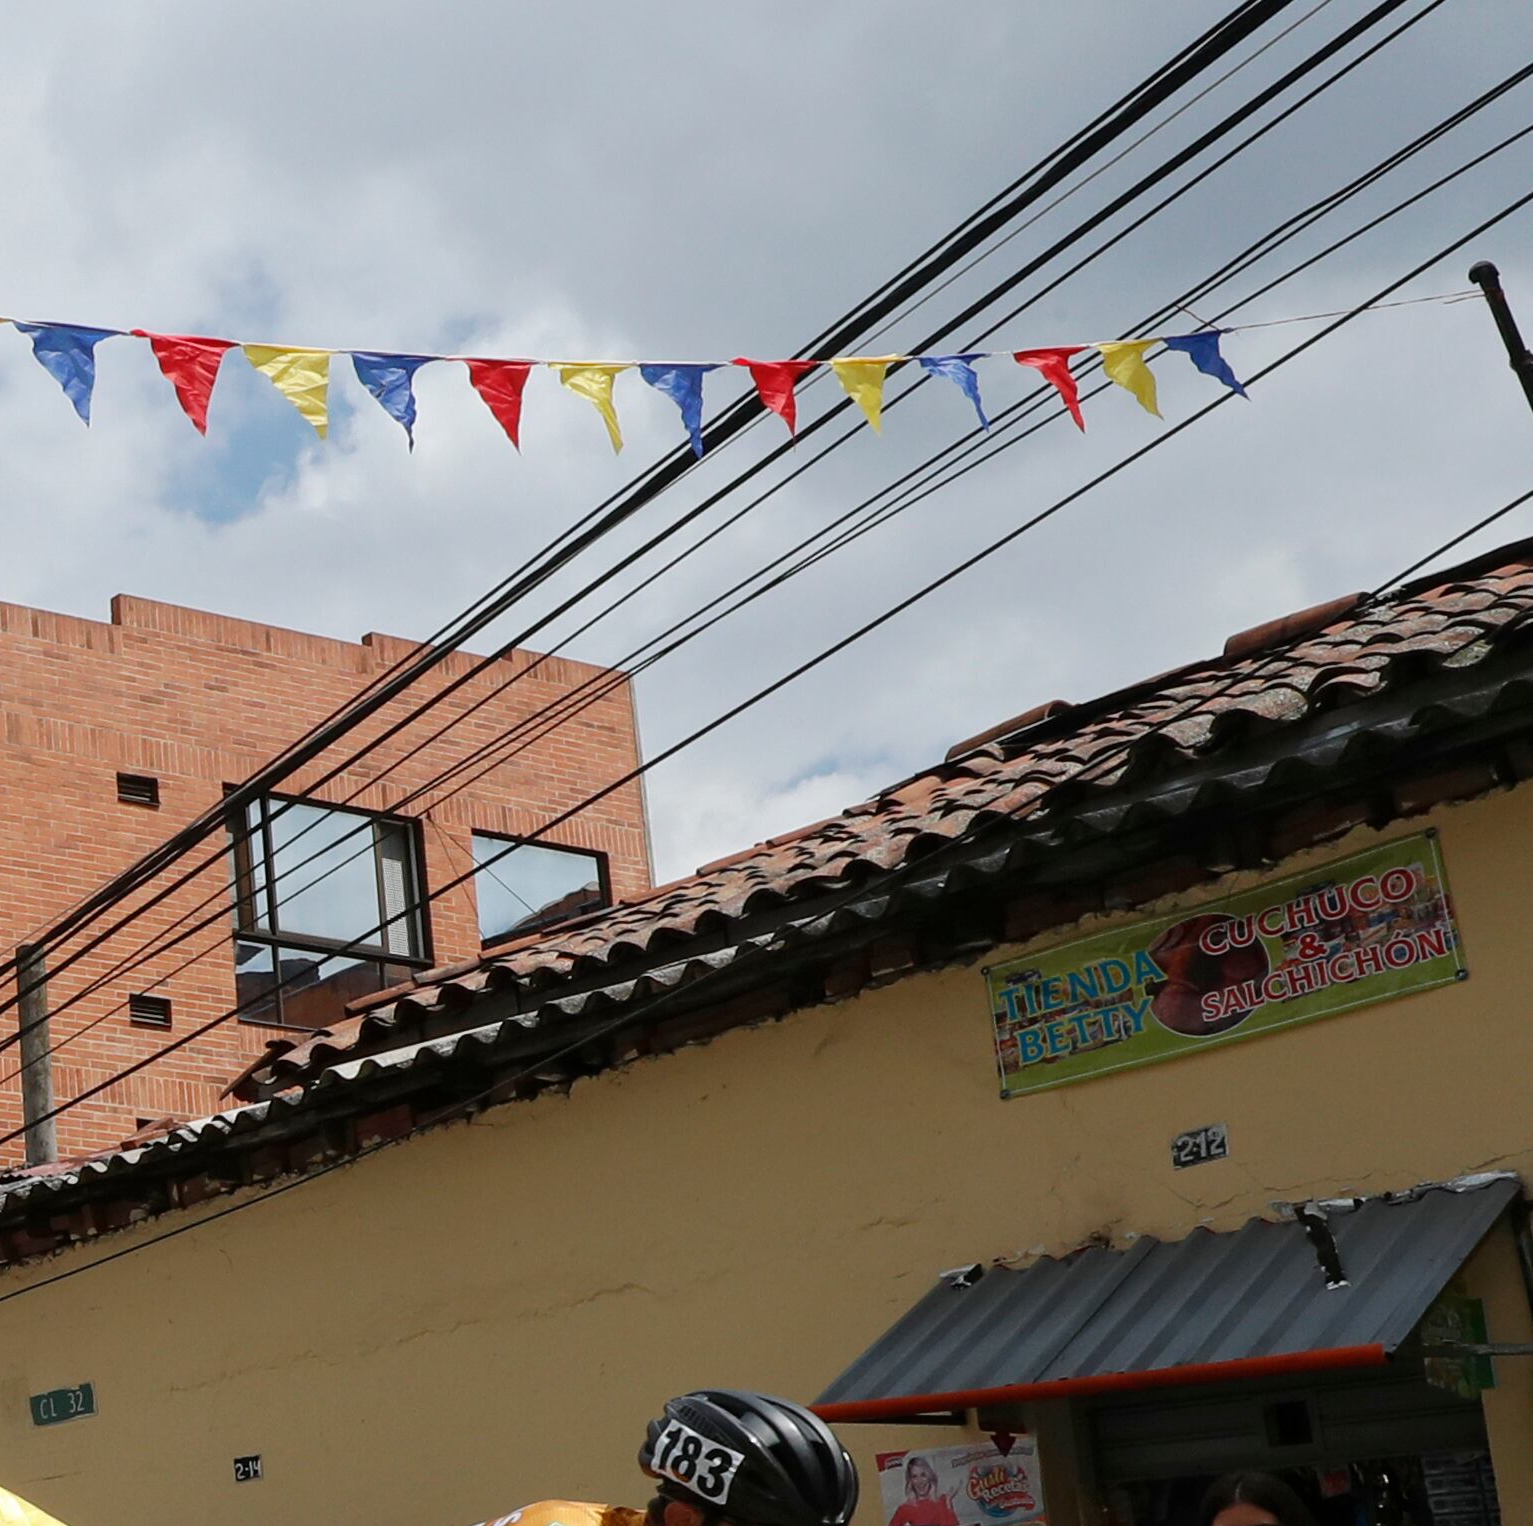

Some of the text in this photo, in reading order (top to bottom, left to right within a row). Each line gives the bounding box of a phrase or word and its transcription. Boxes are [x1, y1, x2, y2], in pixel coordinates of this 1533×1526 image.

[1197, 866, 1416, 956] CUCHUCO
[1297, 931, 1328, 960] &
[996, 949, 1168, 1023] TIENDA
[1200, 929, 1449, 1023] SALCHICHÓN
[1016, 997, 1154, 1065] BETTY
[39, 1391, 85, 1420] CL 32
[234, 1460, 262, 1481] 2-14
[656, 1426, 733, 1499] 183
